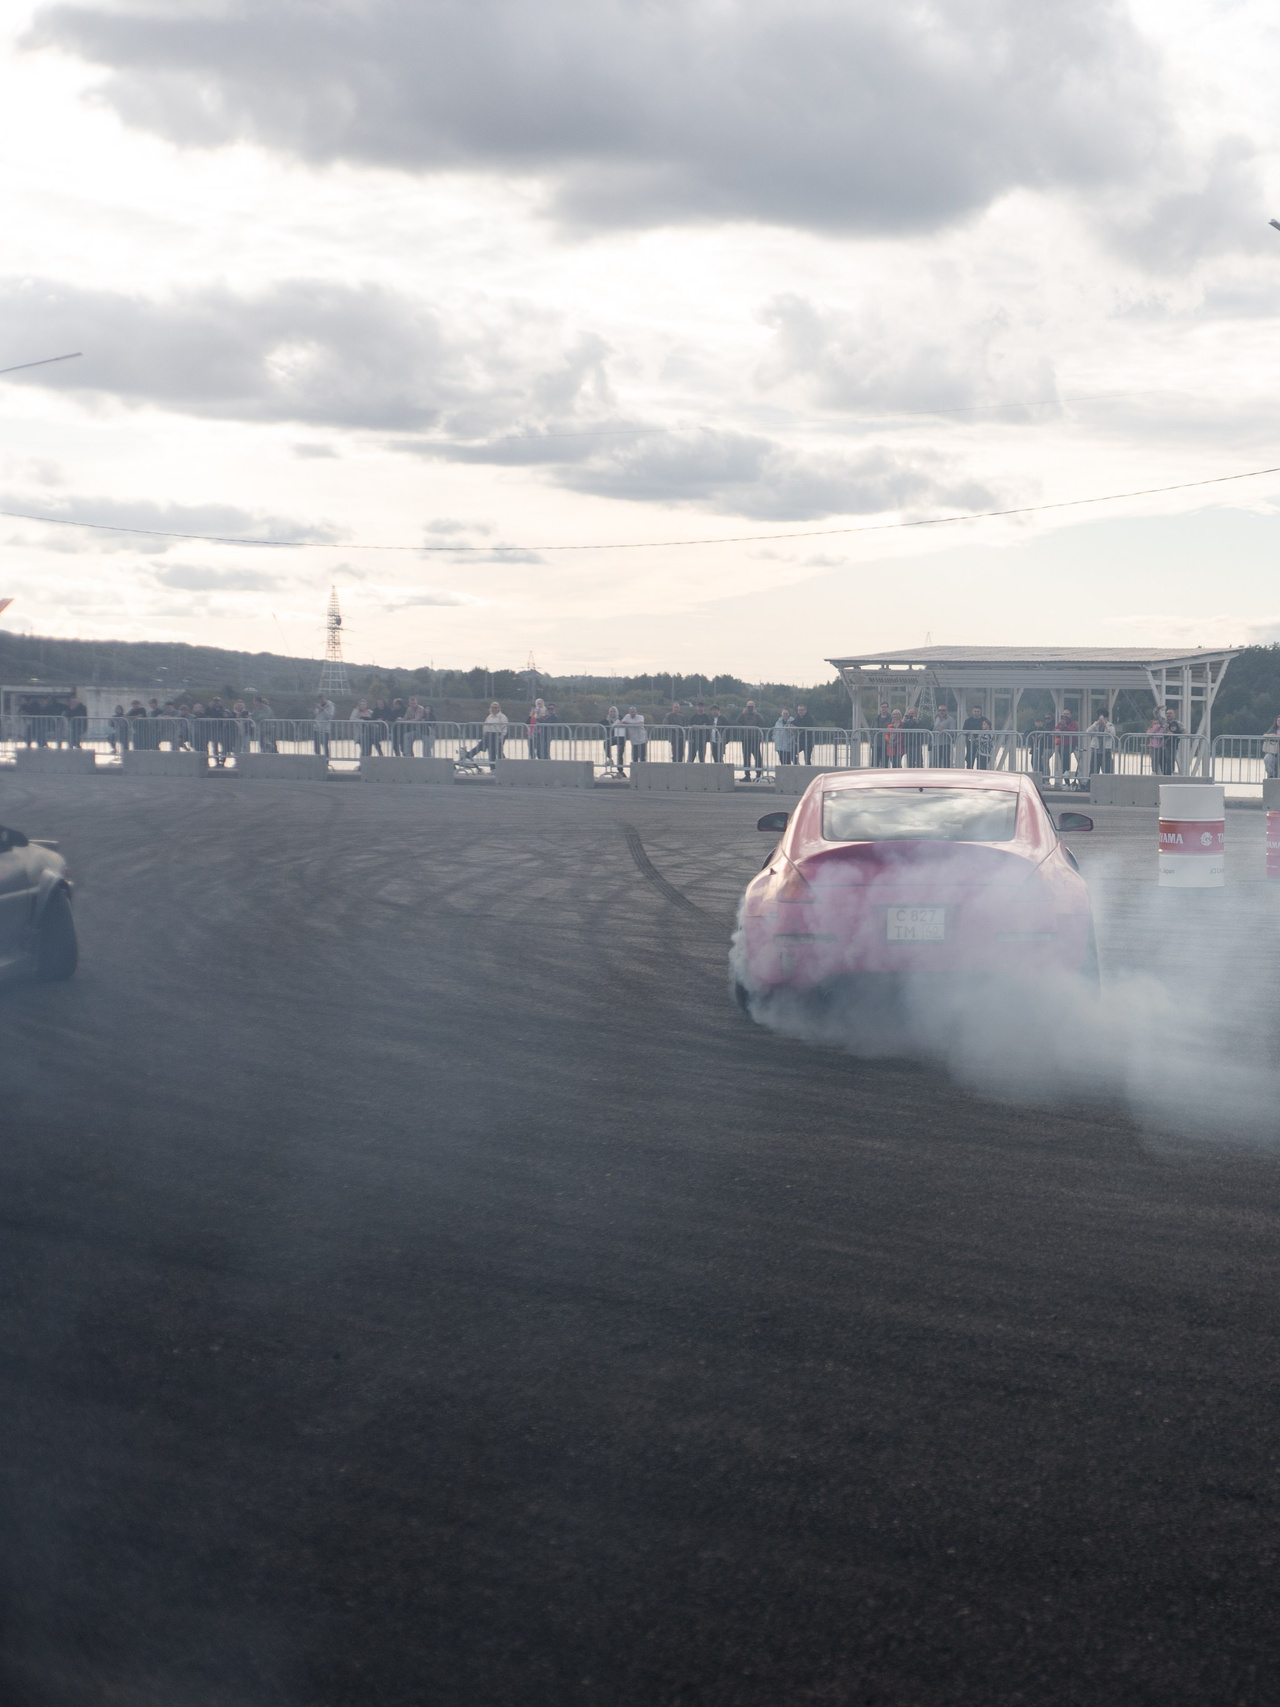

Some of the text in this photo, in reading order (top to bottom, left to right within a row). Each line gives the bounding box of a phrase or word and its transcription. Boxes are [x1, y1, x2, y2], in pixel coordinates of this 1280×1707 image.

[896, 909, 936, 922] C 827
[894, 925, 915, 938] TM
